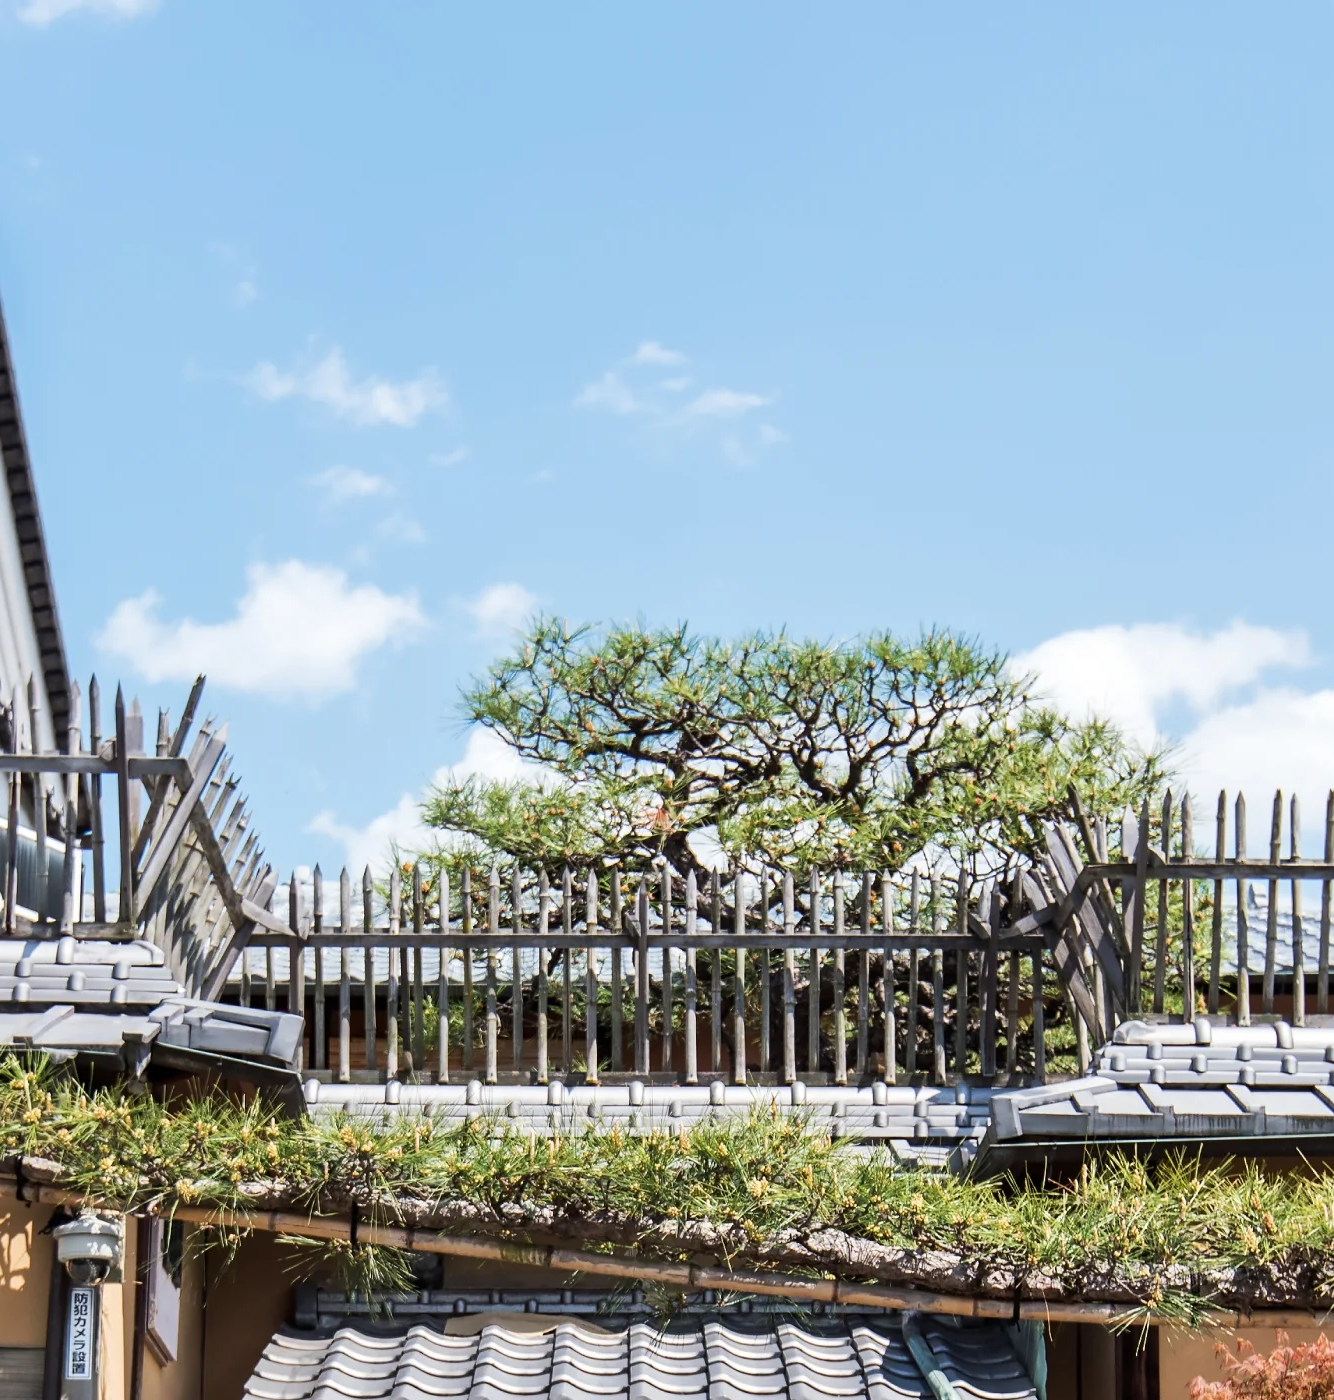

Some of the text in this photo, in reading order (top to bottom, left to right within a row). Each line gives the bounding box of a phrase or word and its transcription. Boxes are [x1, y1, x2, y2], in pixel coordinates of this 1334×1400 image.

[72, 1292, 88, 1374] 防犯カメラ設置
